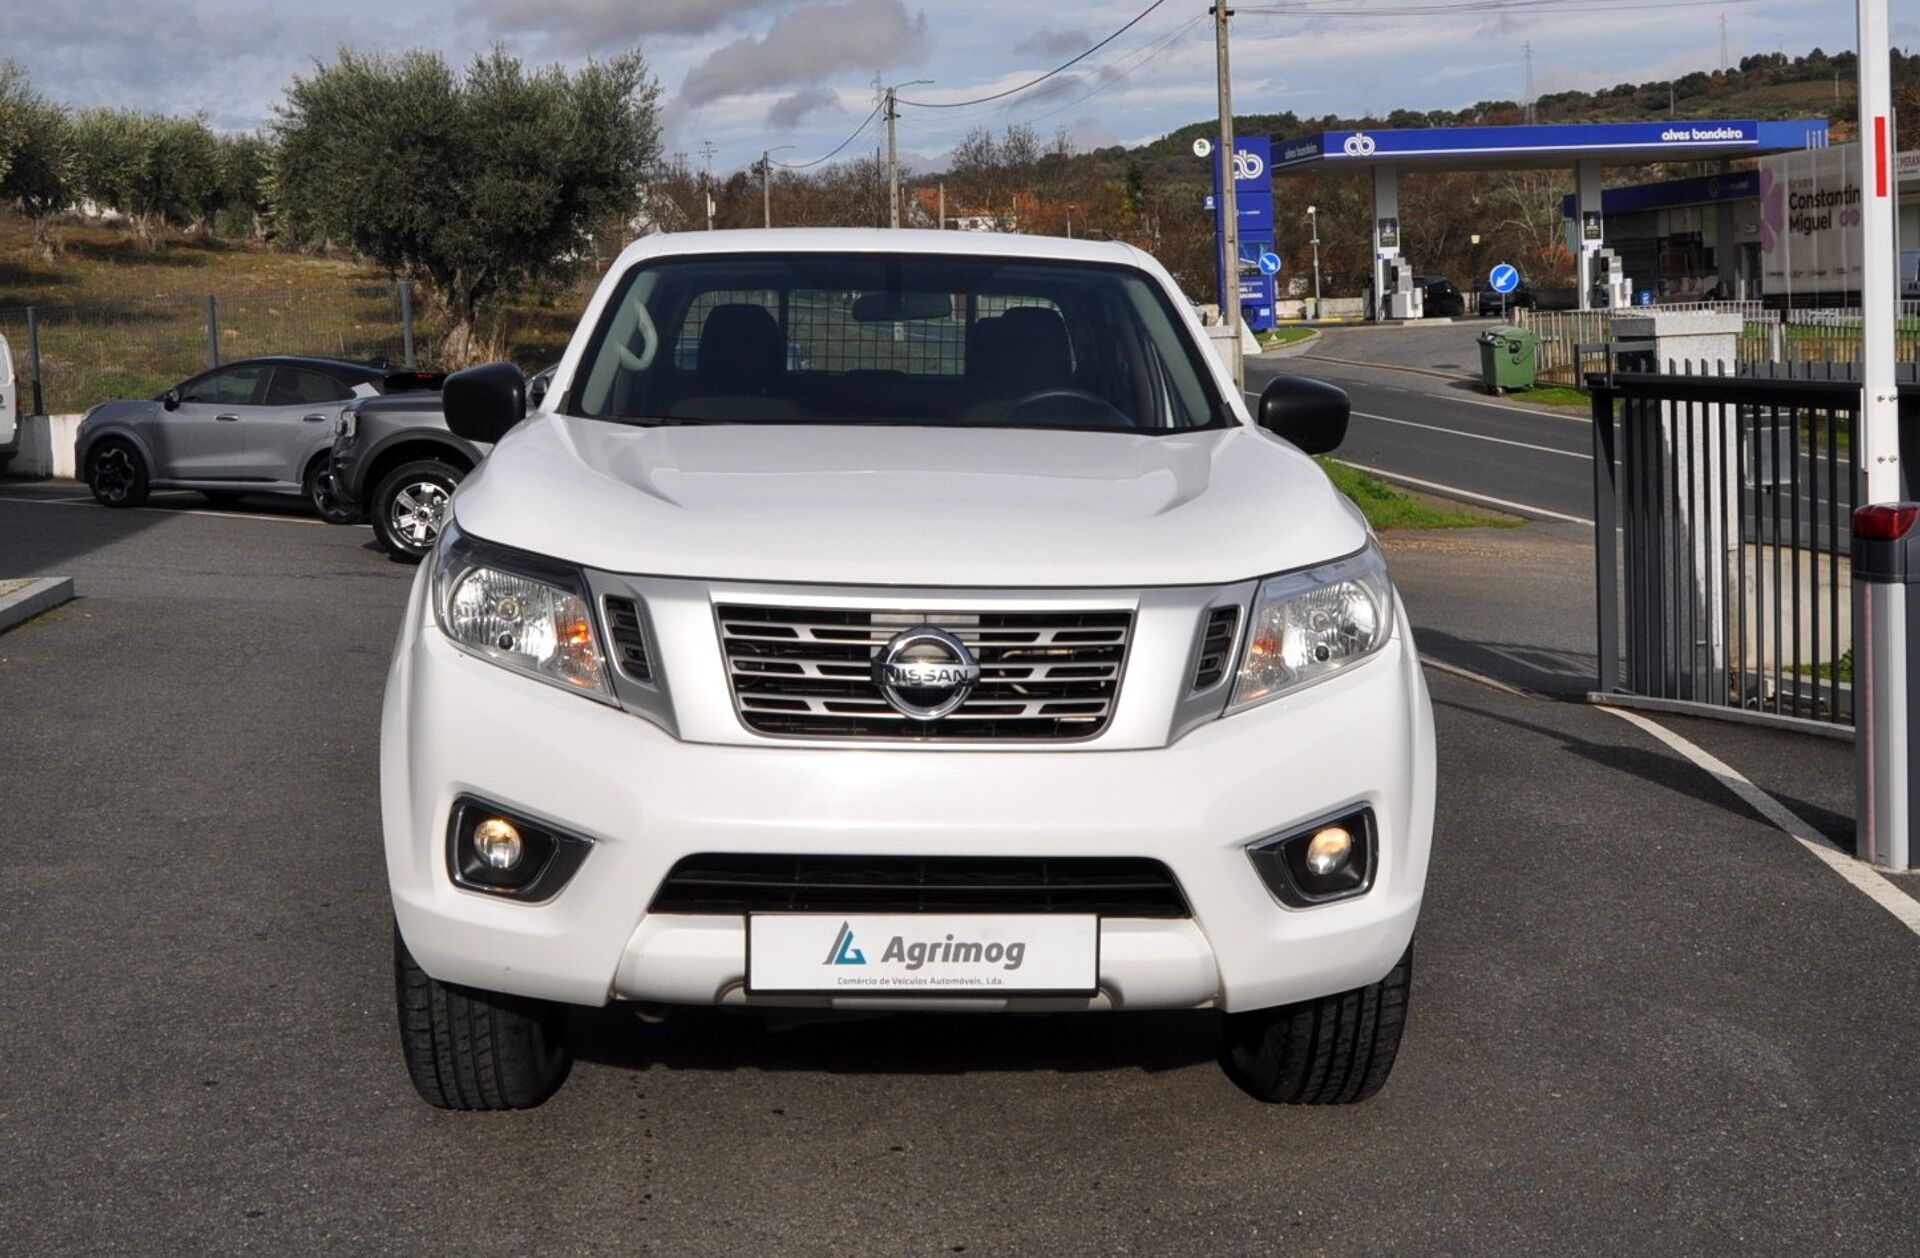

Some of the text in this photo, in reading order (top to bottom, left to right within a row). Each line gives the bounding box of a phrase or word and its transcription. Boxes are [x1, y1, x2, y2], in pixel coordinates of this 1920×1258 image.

[1661, 127, 1743, 141] alves bandeira
[1789, 211, 1832, 235] Miguel
[883, 669, 969, 683] NISSAN
[881, 933, 1026, 970] Agrimog
[837, 976, 877, 985] Comércio
[879, 976, 890, 985] de
[892, 976, 928, 985] Veículos
